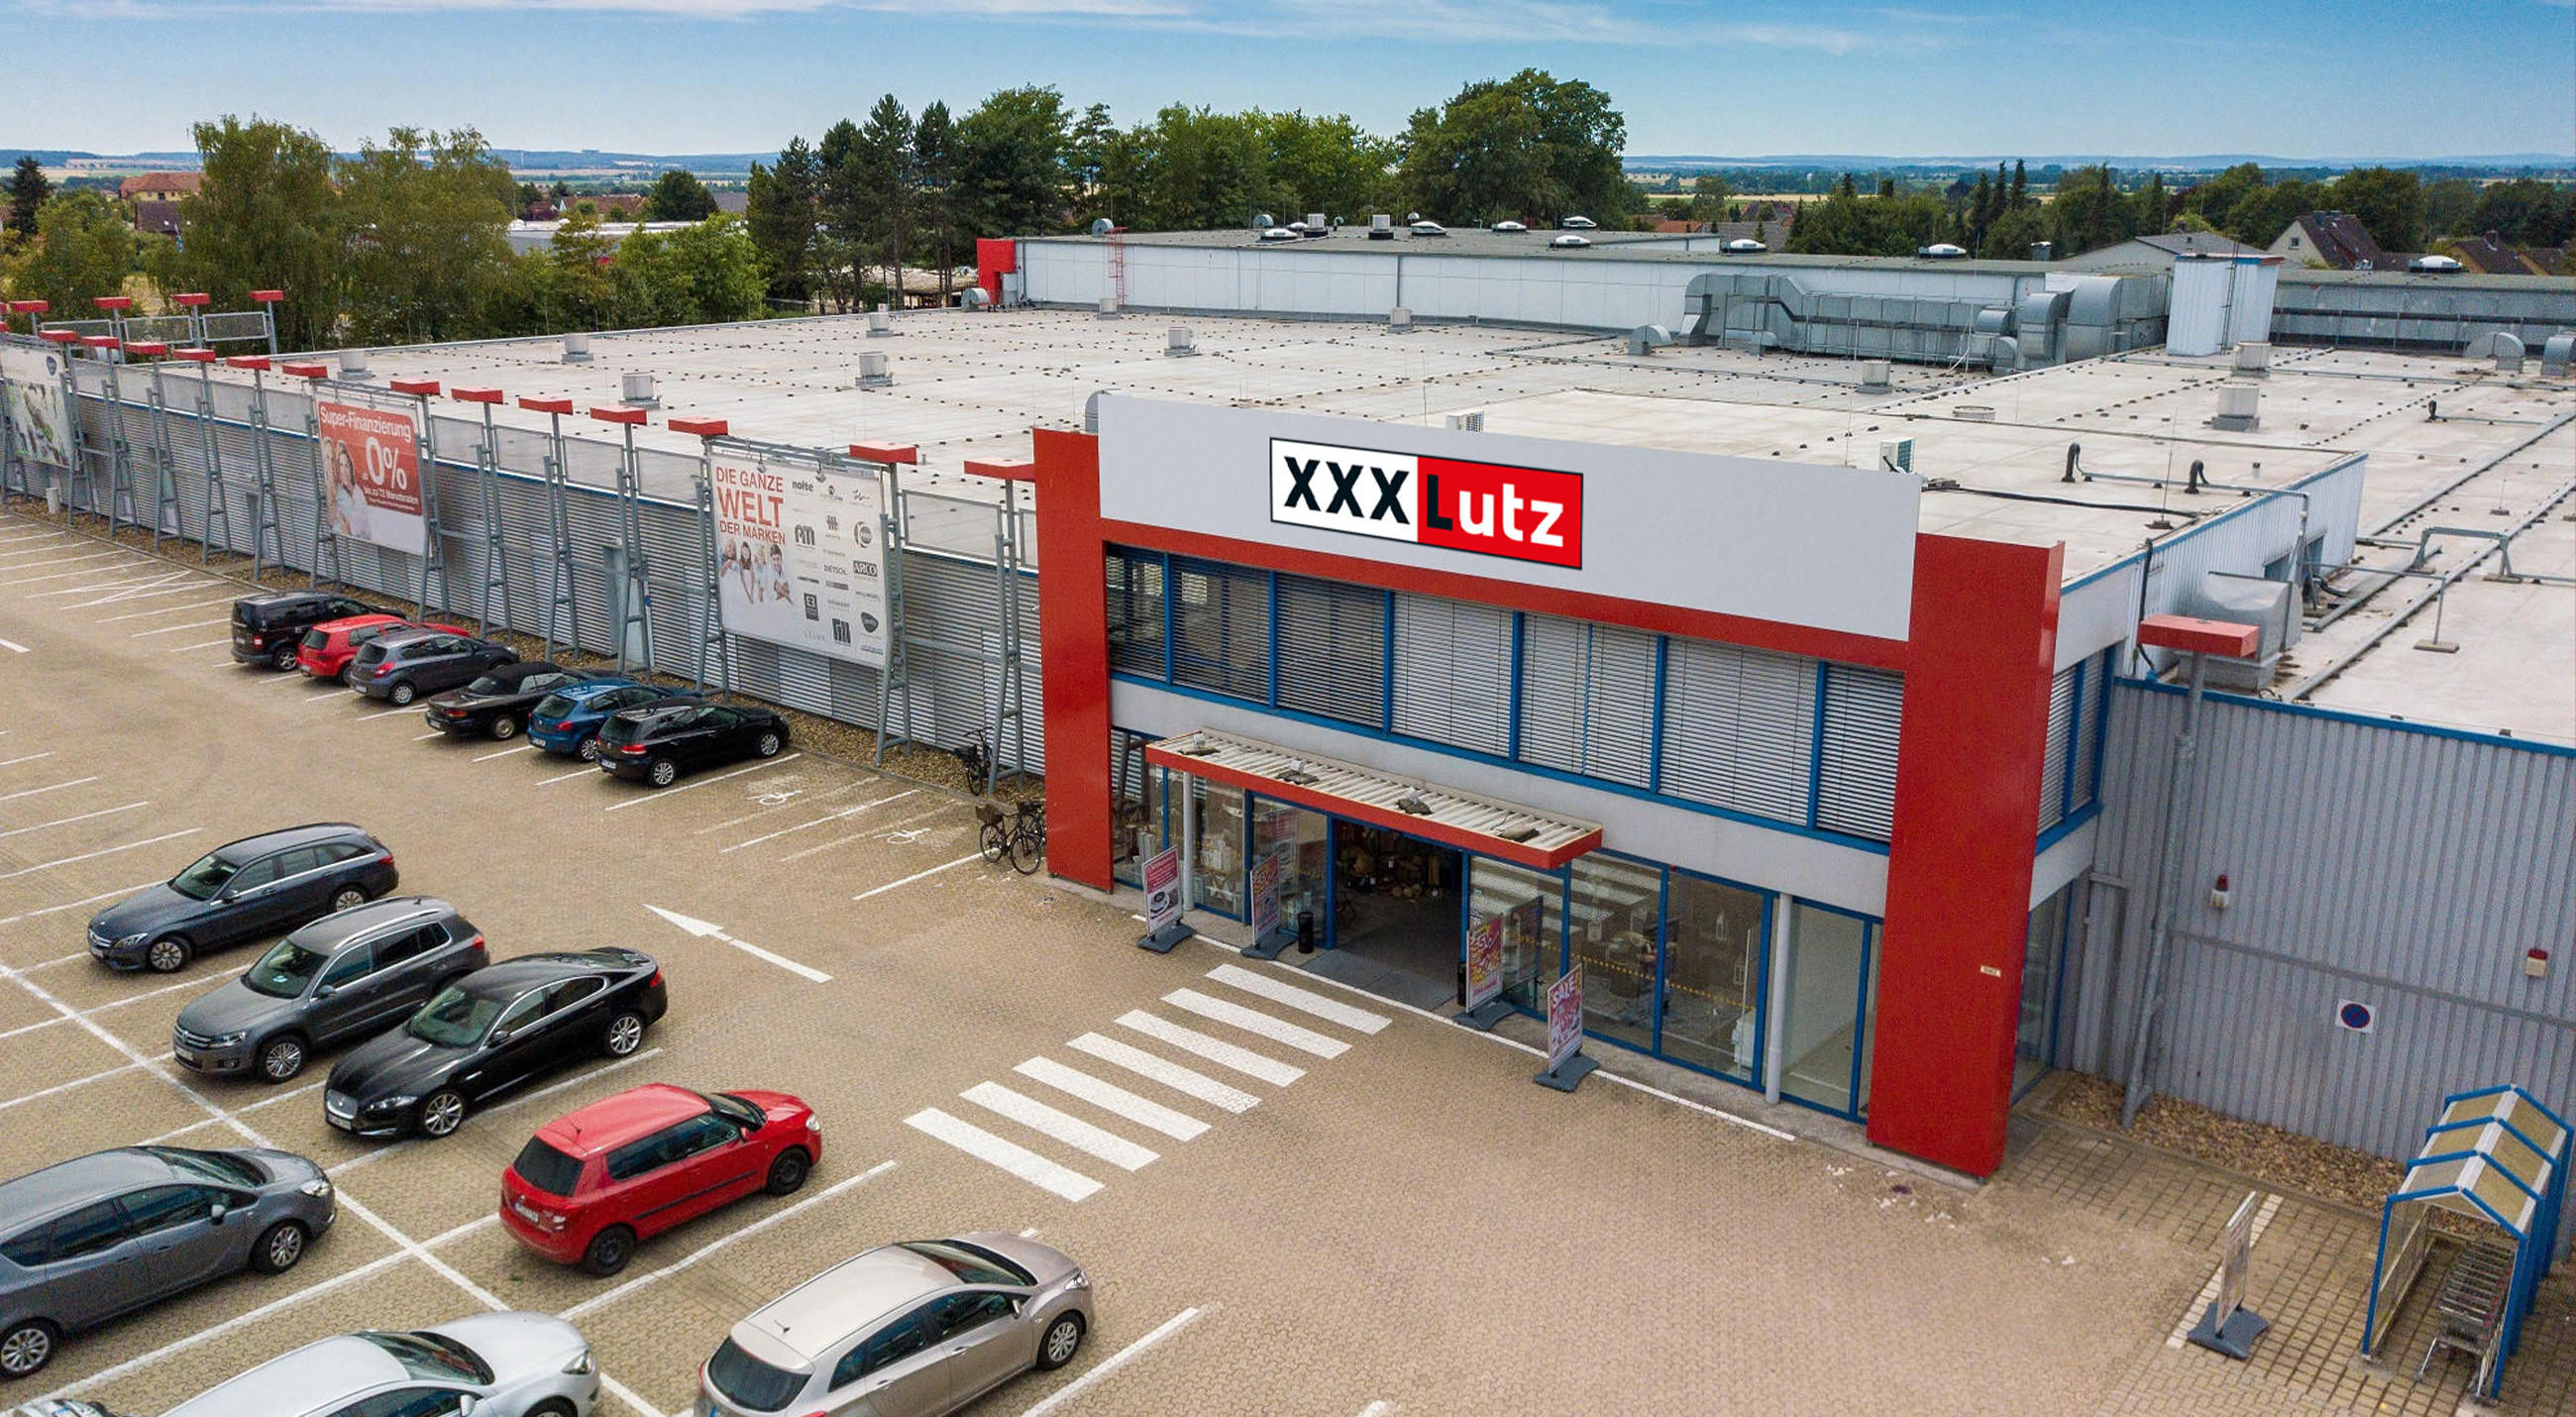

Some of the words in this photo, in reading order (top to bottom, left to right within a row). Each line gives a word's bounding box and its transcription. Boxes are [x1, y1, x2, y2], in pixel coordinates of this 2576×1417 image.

[320, 405, 412, 443] Super-Finanzierung
[366, 436, 408, 490] 0%
[716, 467, 736, 485] DIE
[740, 471, 785, 493] GANZE
[792, 481, 814, 492] nolte
[716, 487, 785, 528] WELT
[719, 520, 740, 535] DER
[743, 526, 786, 545] MARKEN
[853, 561, 878, 577] ARCO
[1553, 974, 1575, 1009] SALE
